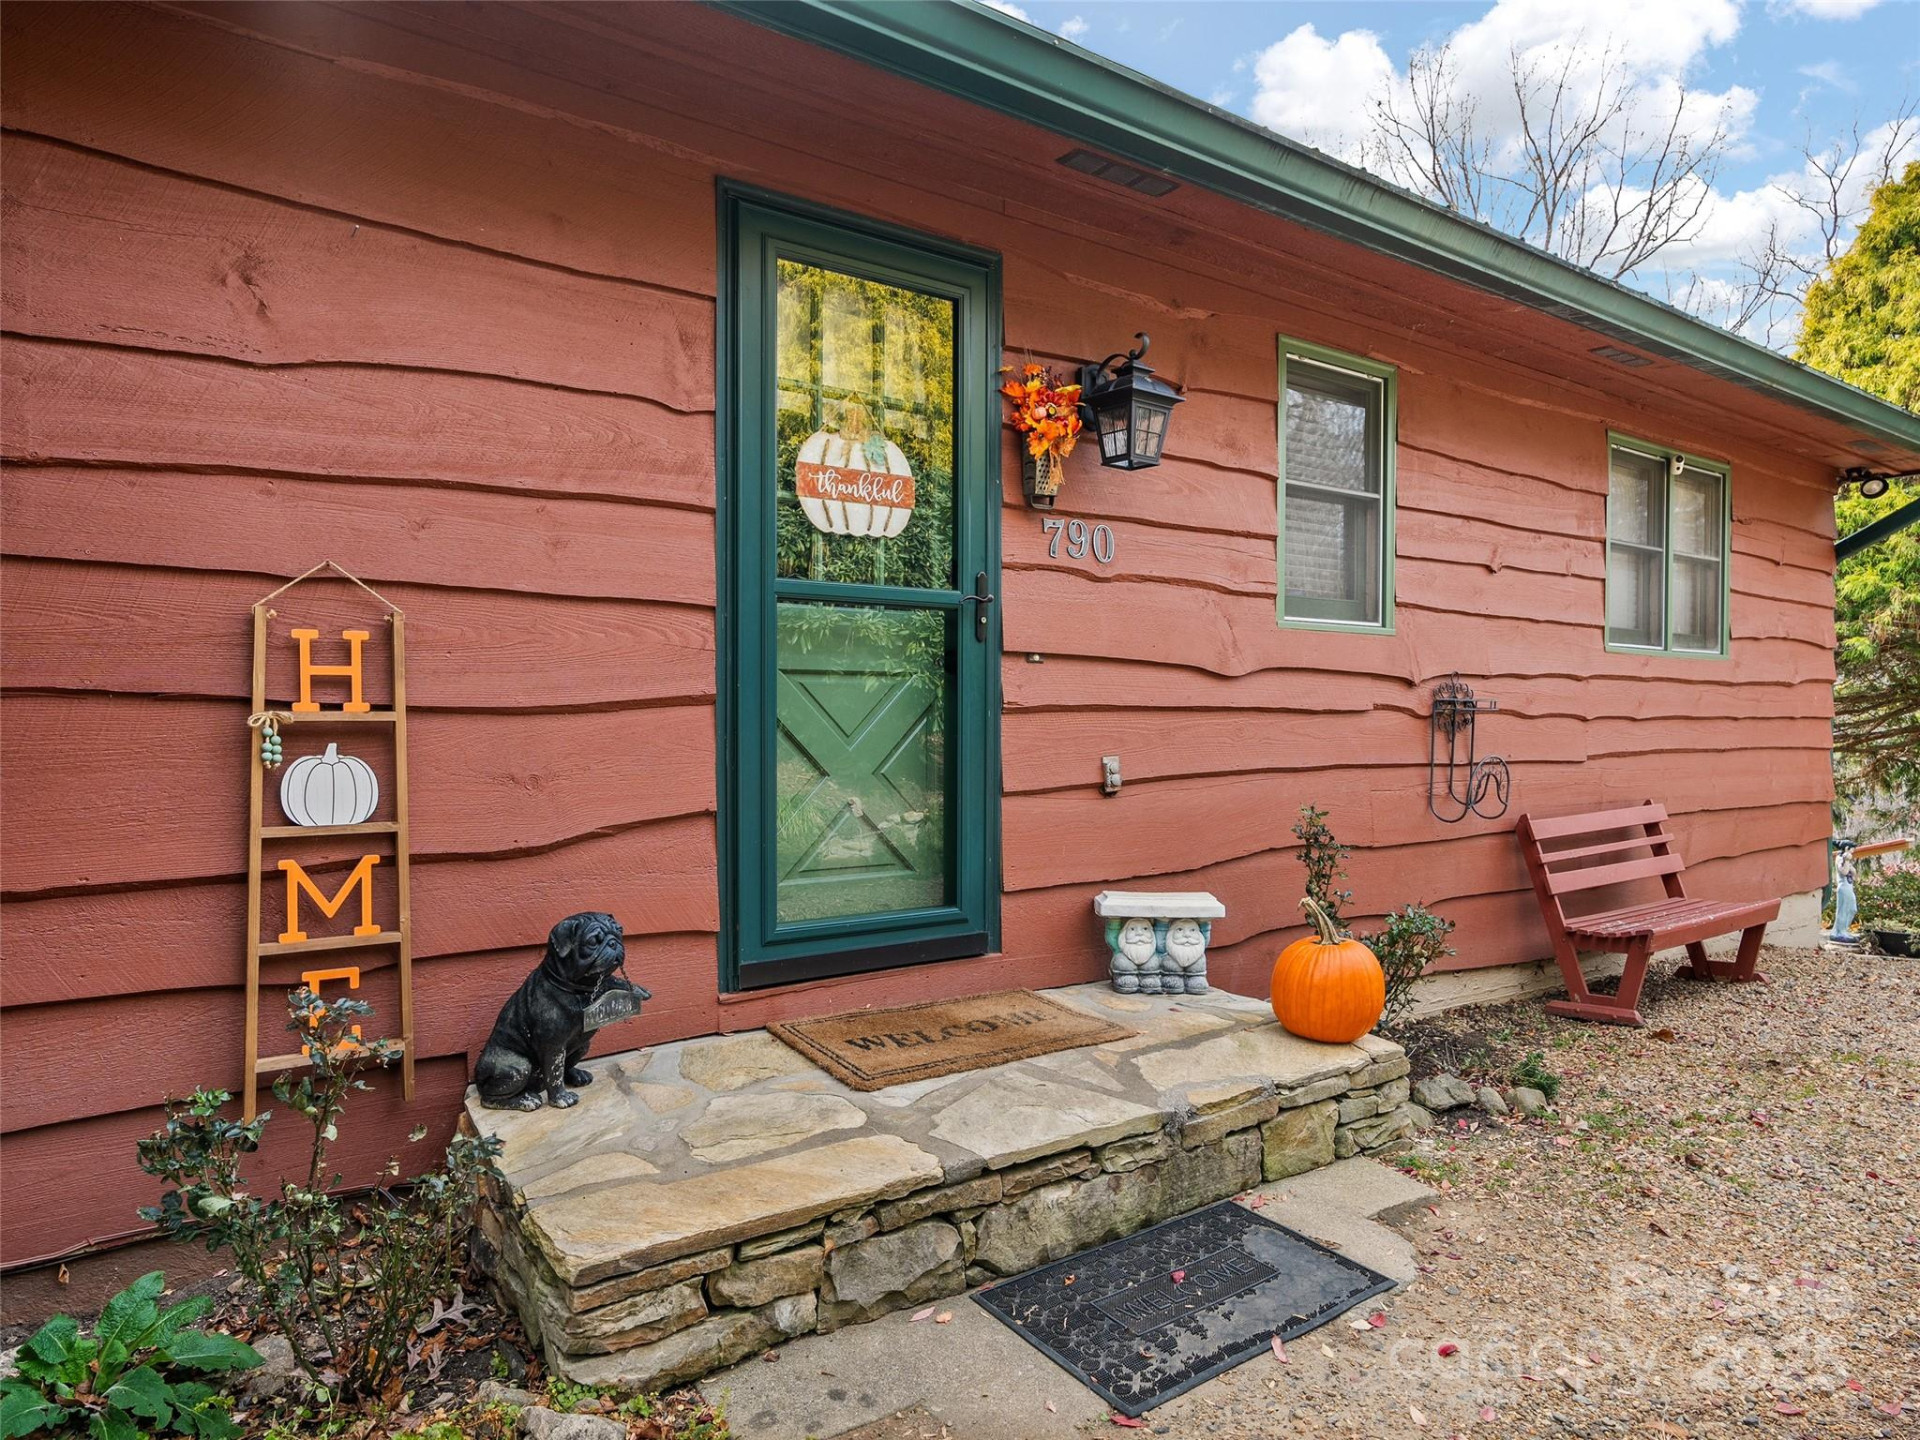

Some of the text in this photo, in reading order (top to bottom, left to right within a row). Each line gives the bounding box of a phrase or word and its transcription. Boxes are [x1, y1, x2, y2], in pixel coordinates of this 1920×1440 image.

[808, 469, 904, 503] thankful
[1042, 516, 1116, 564] 790
[844, 1010, 1057, 1051] WELCOME
[1115, 1256, 1256, 1320] WELCOME
